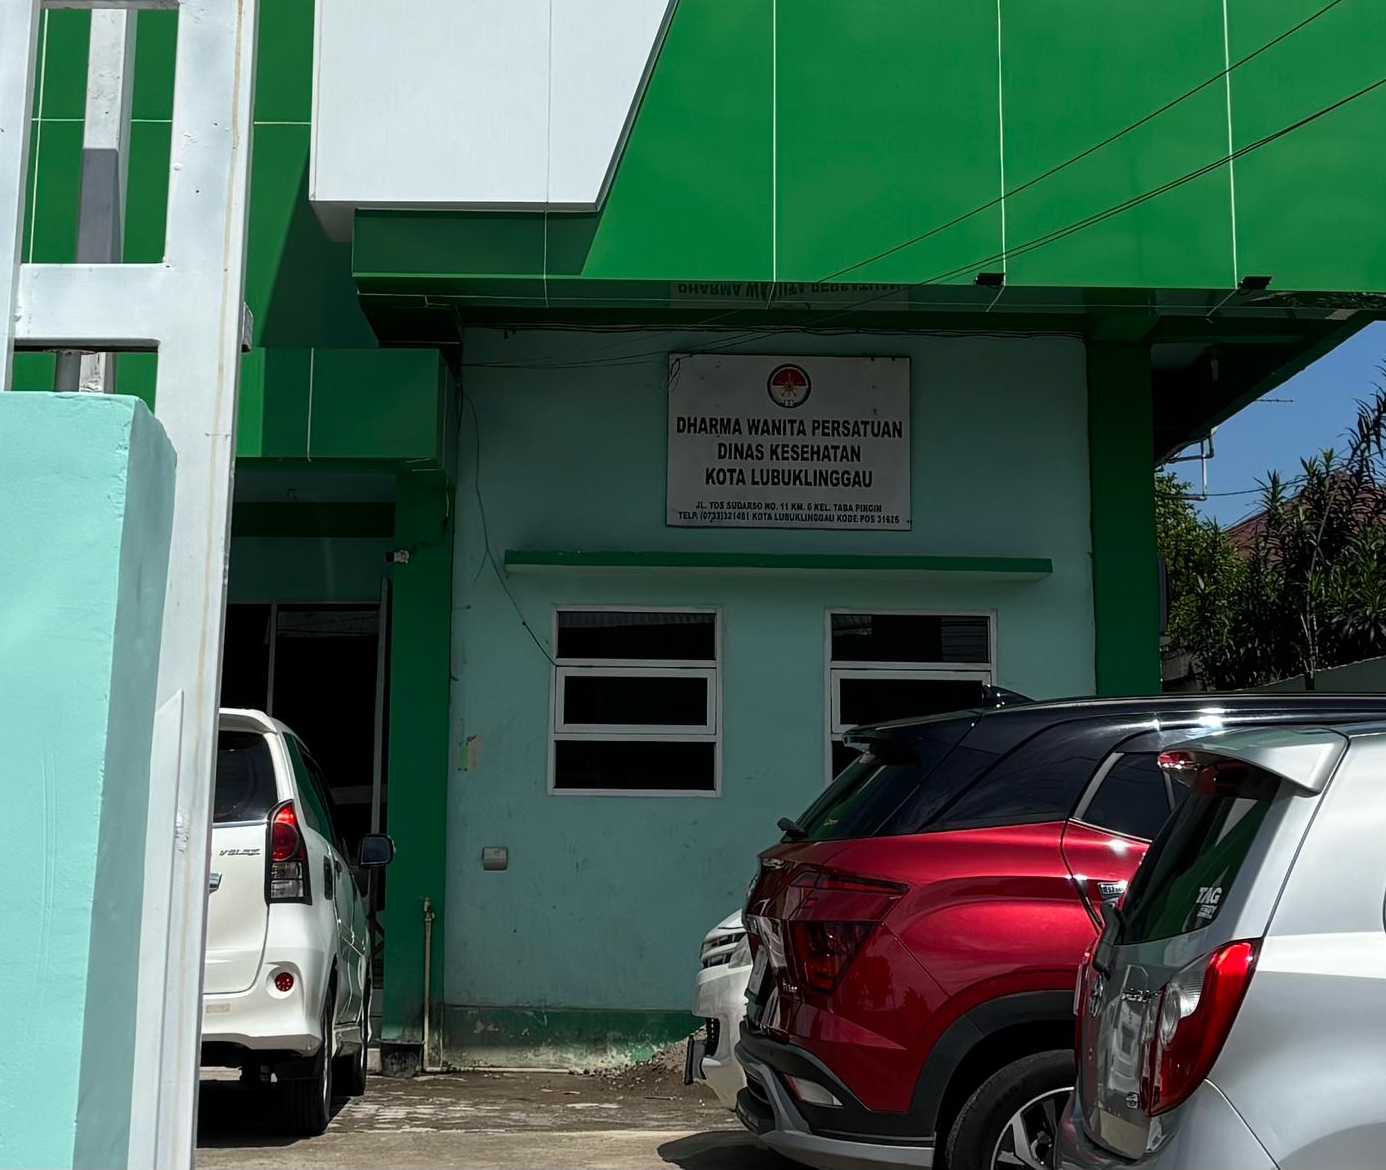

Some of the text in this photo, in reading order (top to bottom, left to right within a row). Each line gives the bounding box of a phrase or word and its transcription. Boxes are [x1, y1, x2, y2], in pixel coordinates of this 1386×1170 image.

[676, 416, 903, 438] DHARMA WANITA PERSATUAN
[717, 442, 861, 463] DINAS KESEHATAN
[705, 467, 873, 488] KOTA LUBUKLINGGAU
[709, 501, 725, 510] YOS
[726, 501, 763, 511] SUDARSO
[833, 503, 854, 512] TABA
[752, 512, 773, 521] KOTA
[774, 513, 835, 522] LUBUKLINGGAU
[836, 514, 858, 523] KODE
[859, 514, 874, 523] POS
